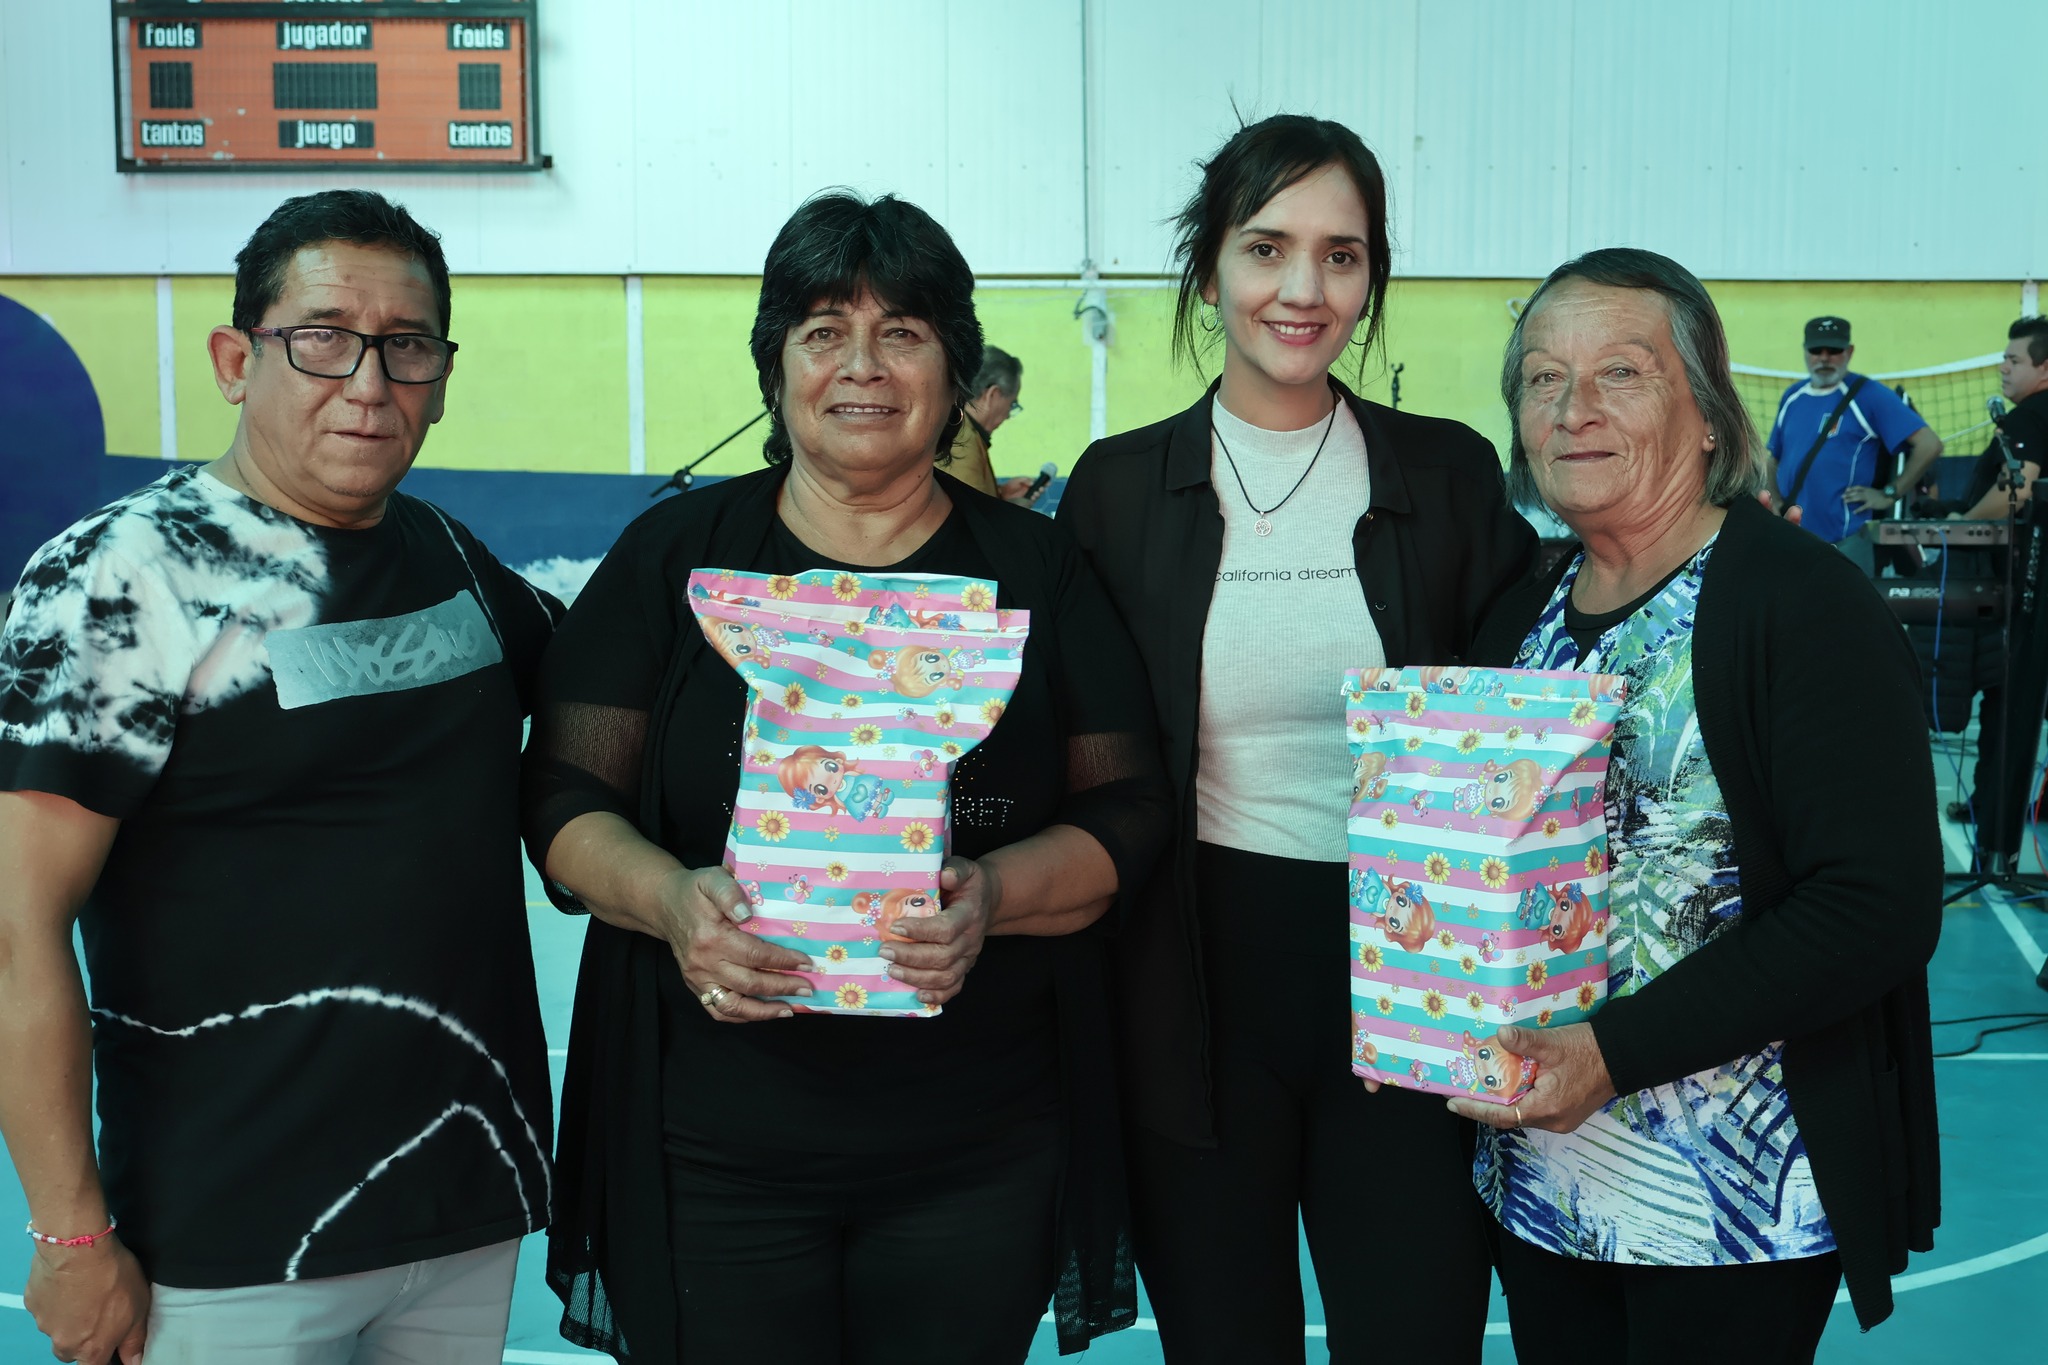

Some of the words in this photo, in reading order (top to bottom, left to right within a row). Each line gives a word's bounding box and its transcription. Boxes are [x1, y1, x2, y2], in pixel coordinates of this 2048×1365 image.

[145, 23, 195, 47] fouls
[281, 21, 367, 50] jugador
[453, 23, 505, 48] fouls
[141, 121, 204, 146] tantos
[295, 120, 356, 150] juego
[449, 121, 512, 147] tantos
